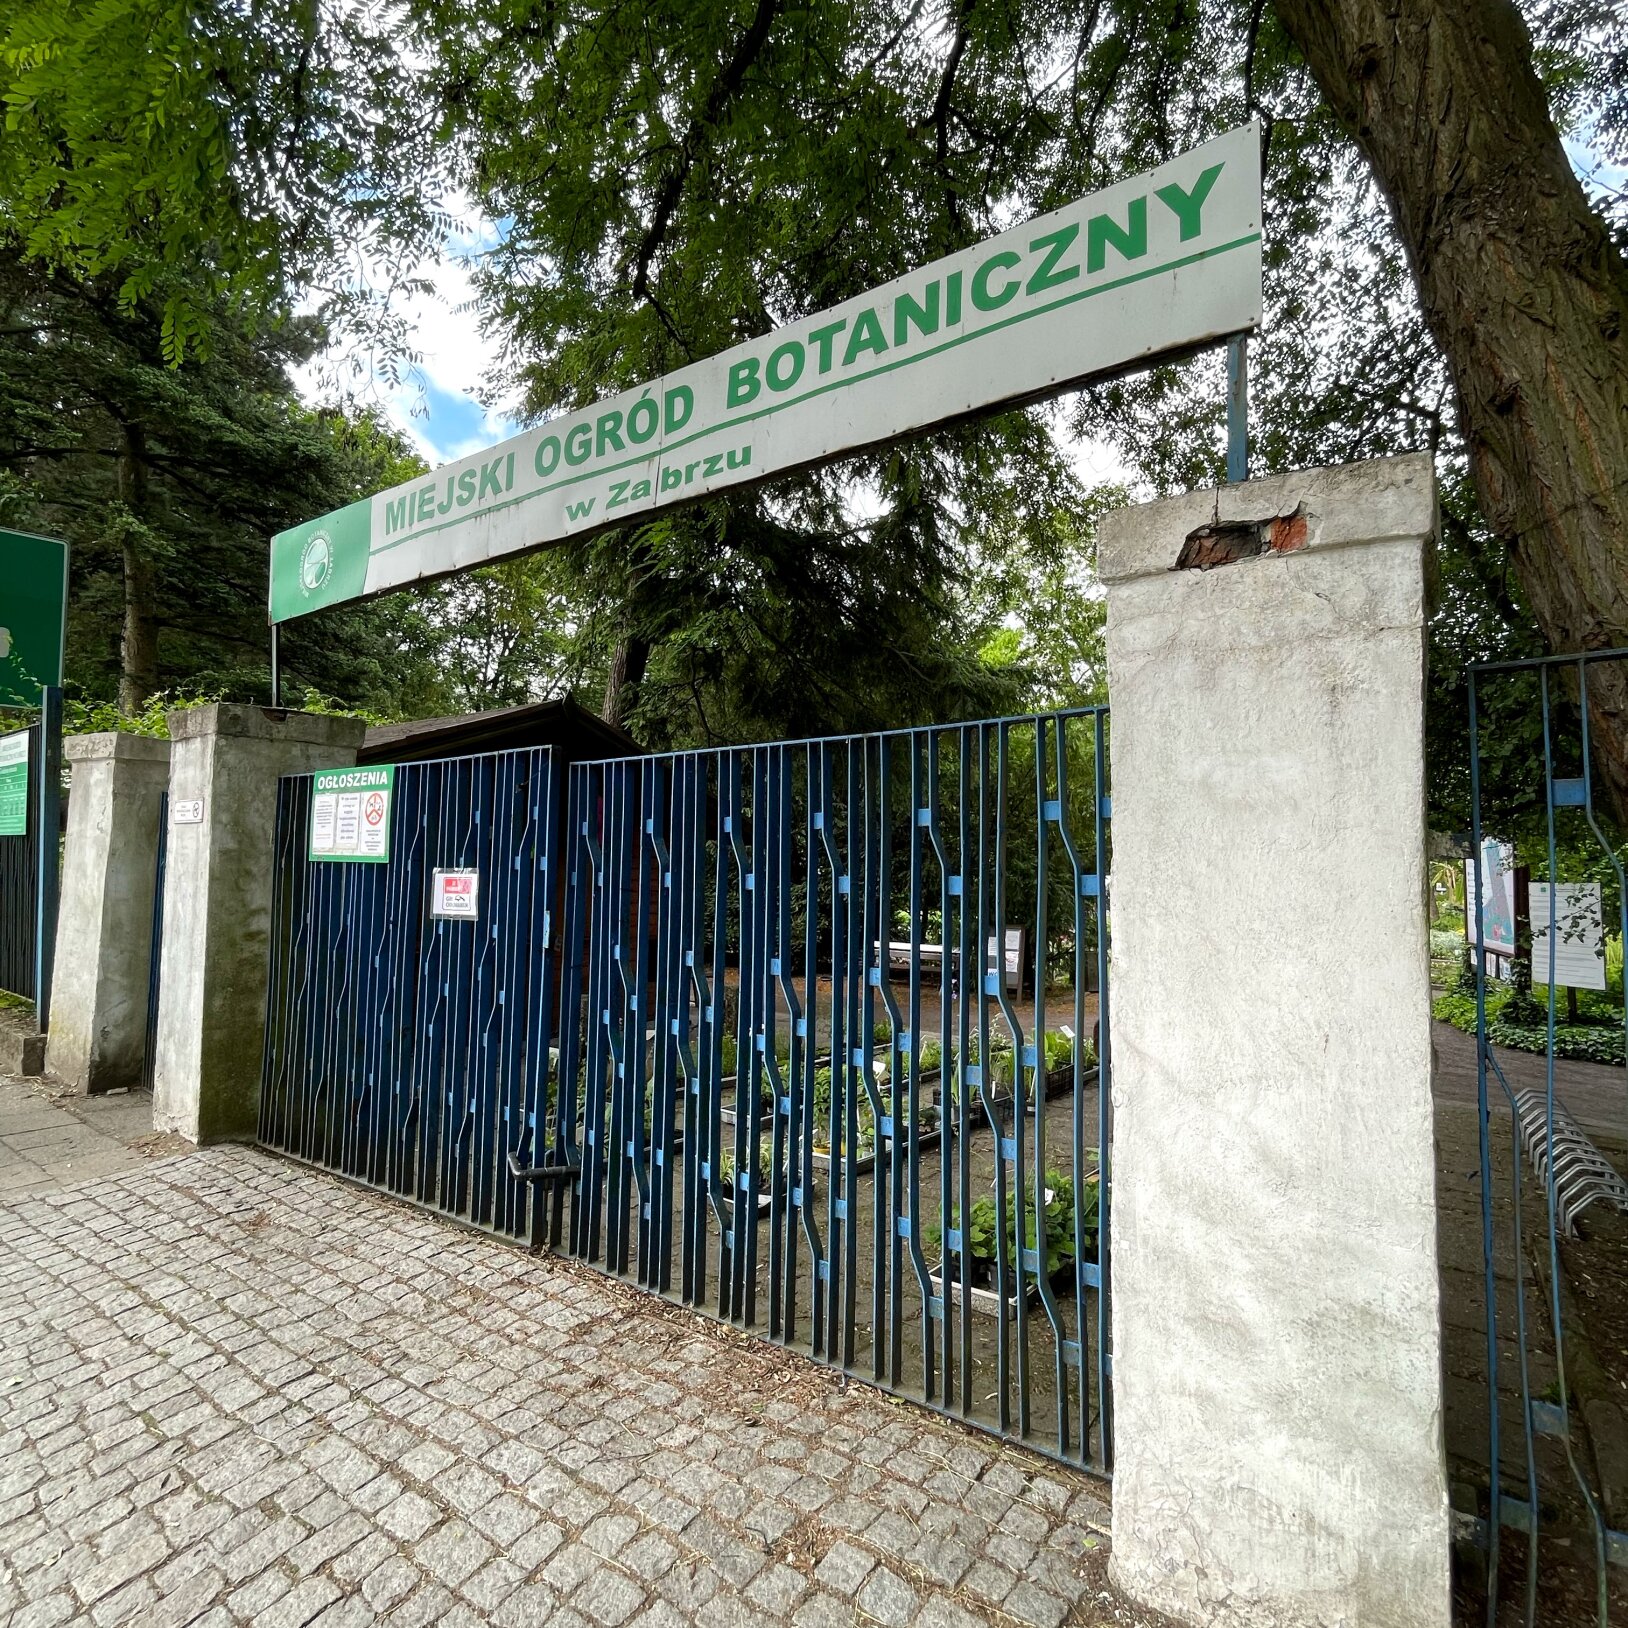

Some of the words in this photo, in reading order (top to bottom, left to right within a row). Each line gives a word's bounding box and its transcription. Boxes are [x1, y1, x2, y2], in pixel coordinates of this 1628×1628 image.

[385, 451, 515, 536] MIEJSKI
[534, 385, 696, 478] OGRÓD
[726, 160, 1225, 409] BOTANICZNY
[565, 496, 597, 521] w
[317, 771, 388, 789] OGŁOSZENIA
